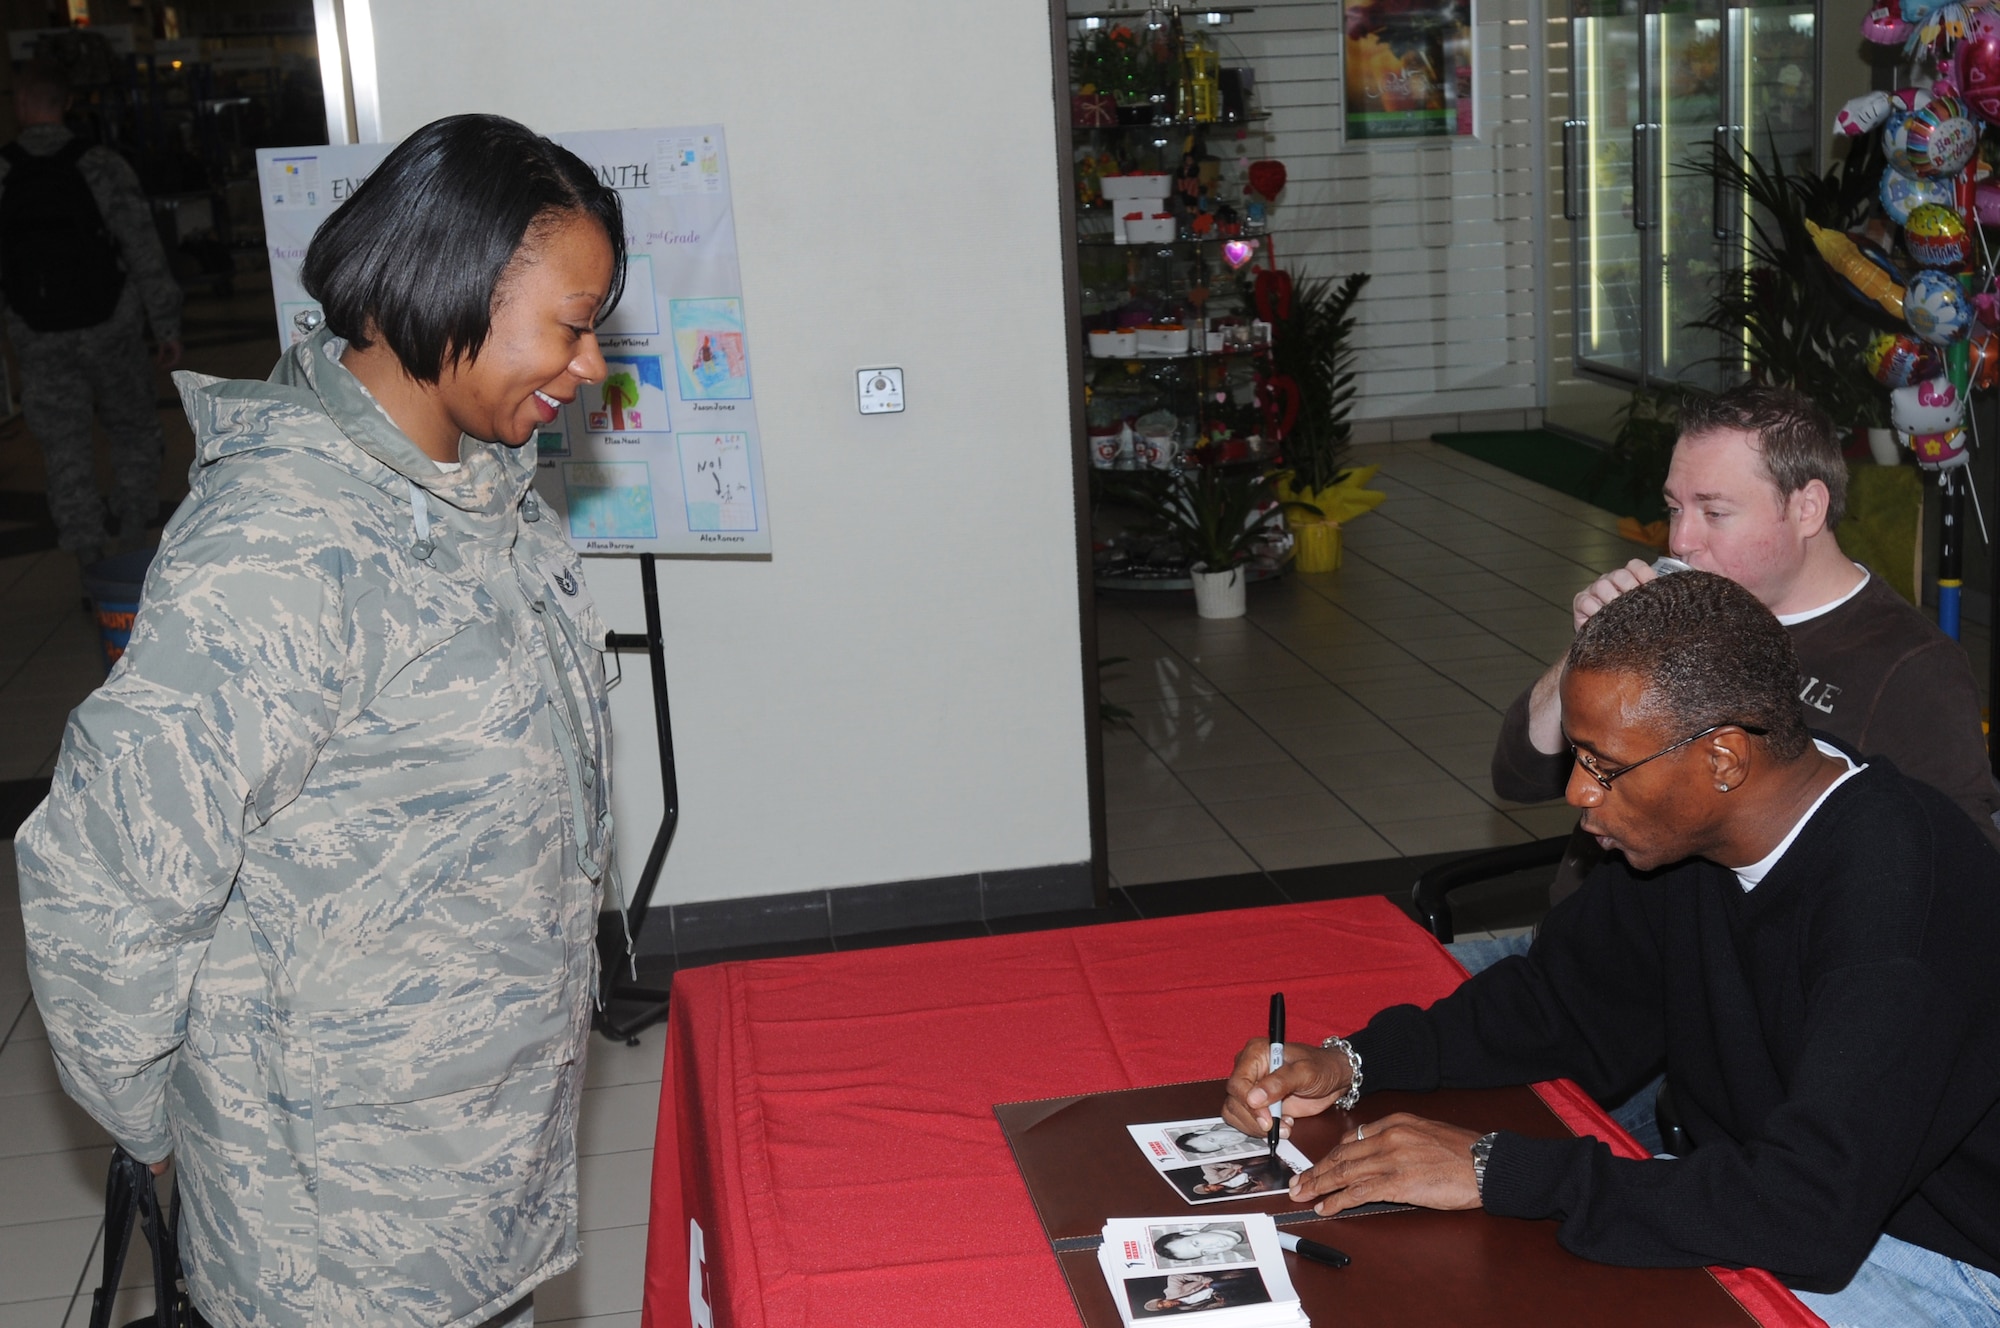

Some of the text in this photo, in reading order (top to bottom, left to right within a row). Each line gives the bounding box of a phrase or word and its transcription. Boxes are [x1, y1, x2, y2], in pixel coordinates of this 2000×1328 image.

[1935, 127, 1968, 154] Happy
[664, 229, 701, 244] Grade
[714, 402, 736, 411] Jones
[700, 533, 745, 543] Alex Romero
[1798, 676, 1843, 714] LE
